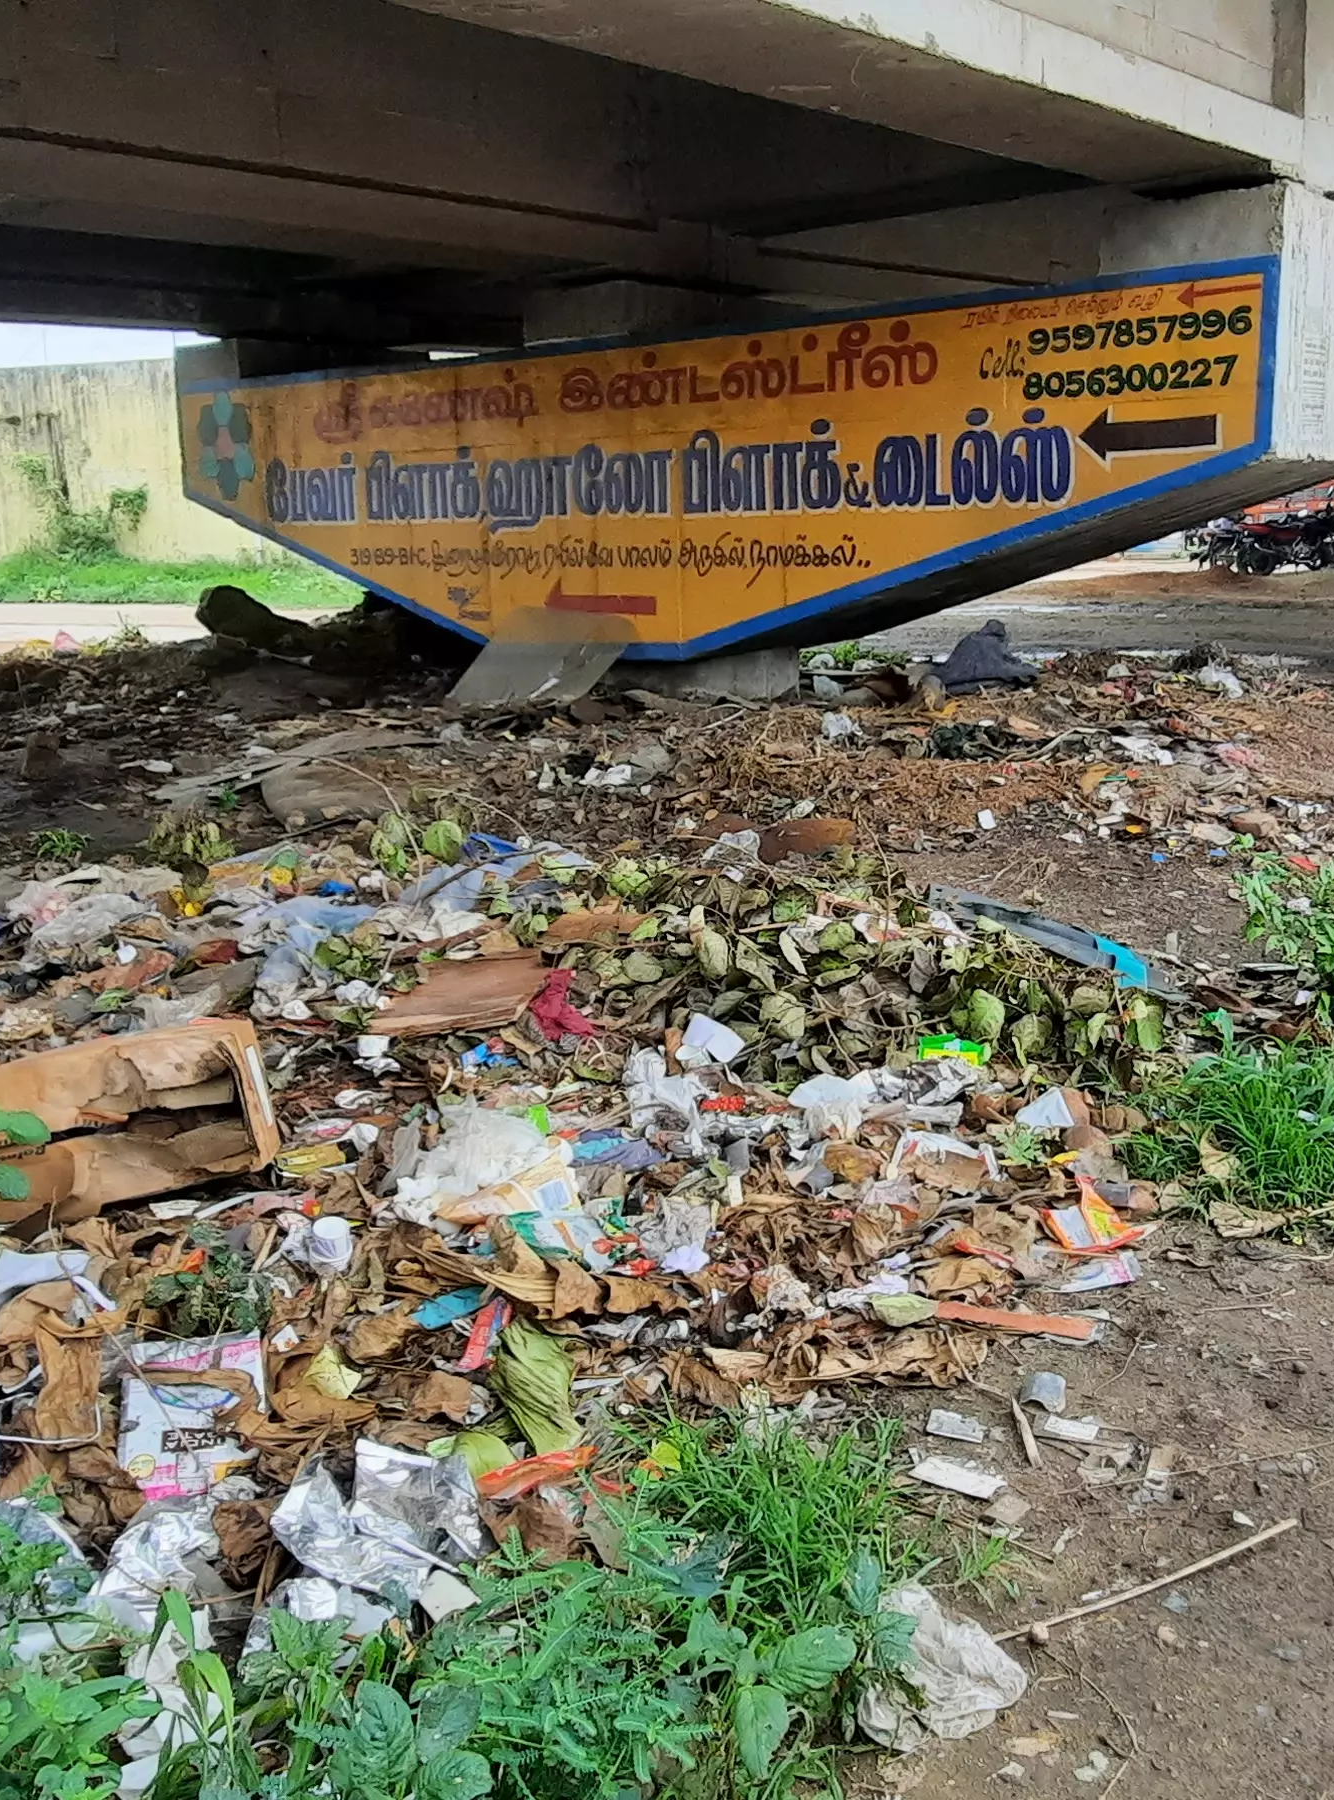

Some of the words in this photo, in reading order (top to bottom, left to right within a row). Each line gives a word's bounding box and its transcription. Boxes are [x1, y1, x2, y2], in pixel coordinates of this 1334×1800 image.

[558, 318, 939, 413] இண்டஸ்ட்ரீஸ்
[1027, 305, 1253, 355] 9597857996
[1022, 354, 1239, 400] 8056300227
[266, 451, 359, 523] பேவர்
[682, 418, 843, 517] பிளாக்
